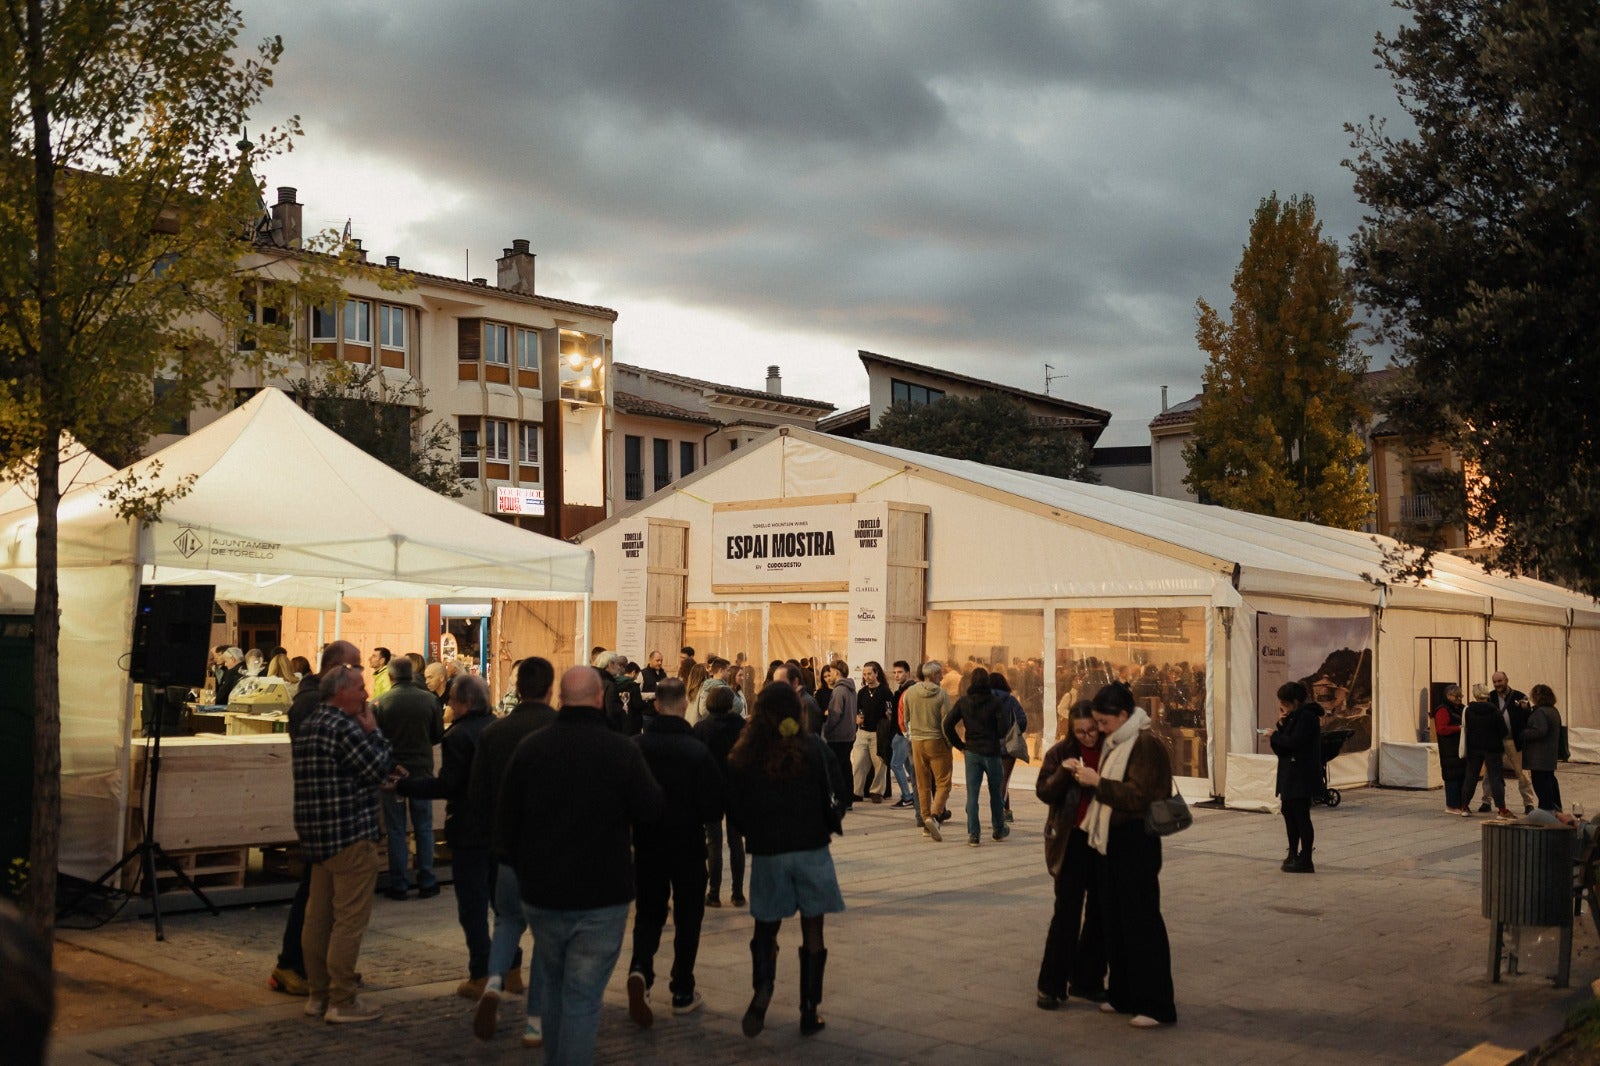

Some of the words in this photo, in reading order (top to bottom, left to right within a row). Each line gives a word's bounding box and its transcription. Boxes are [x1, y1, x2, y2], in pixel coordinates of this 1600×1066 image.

[858, 517, 880, 528] TORELLÓ
[854, 529, 883, 538] MOUNTAIN
[212, 538, 281, 550] AJUNTAMENT
[726, 535, 768, 560] ESPAI
[772, 531, 835, 558] MOSTRA
[859, 539, 878, 548] WINES
[210, 548, 226, 556] DE
